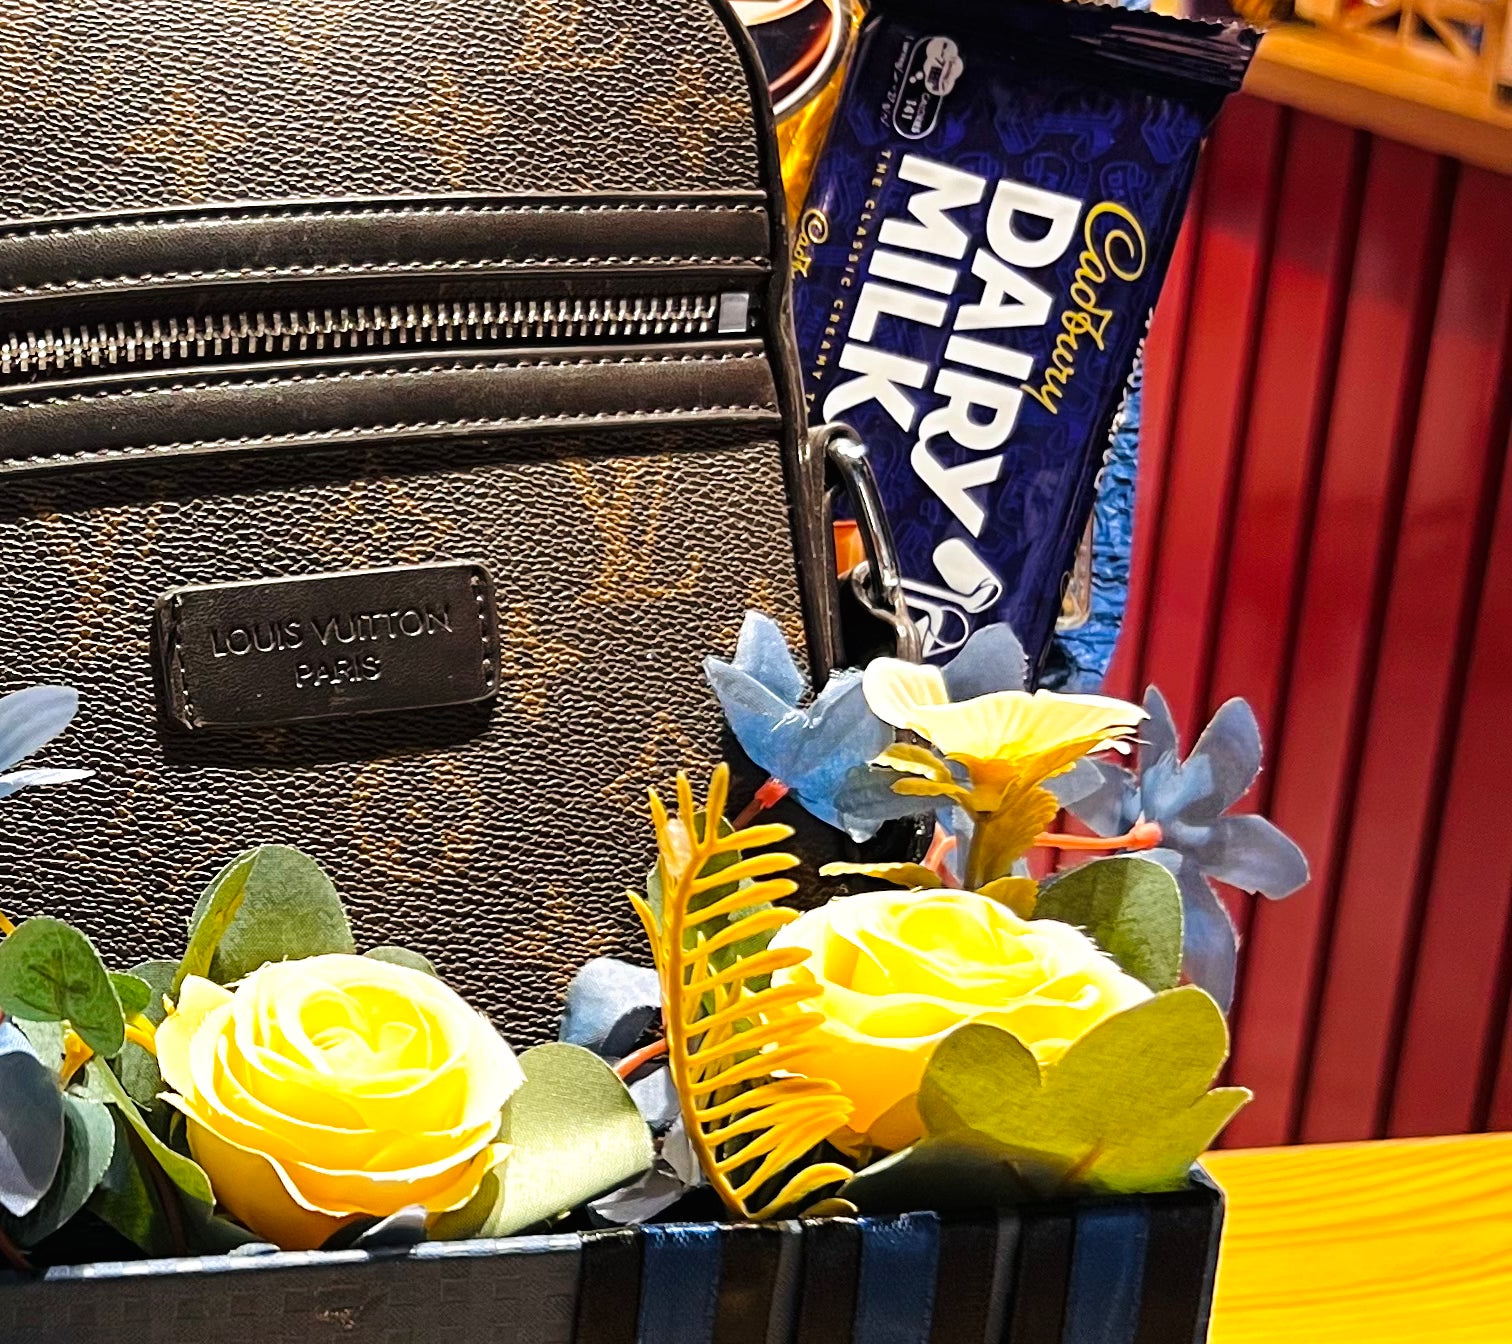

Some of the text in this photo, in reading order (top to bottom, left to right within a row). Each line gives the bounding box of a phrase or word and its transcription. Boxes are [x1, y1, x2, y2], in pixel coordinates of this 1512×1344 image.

[812, 150, 892, 381] THE CLASSIC CREAMY
[822, 154, 986, 433] MILK
[911, 179, 1083, 538] DAIRY
[1023, 201, 1147, 416] Cadbury
[208, 605, 455, 658] LOUIS VUITTON
[295, 656, 383, 690] PARIS
